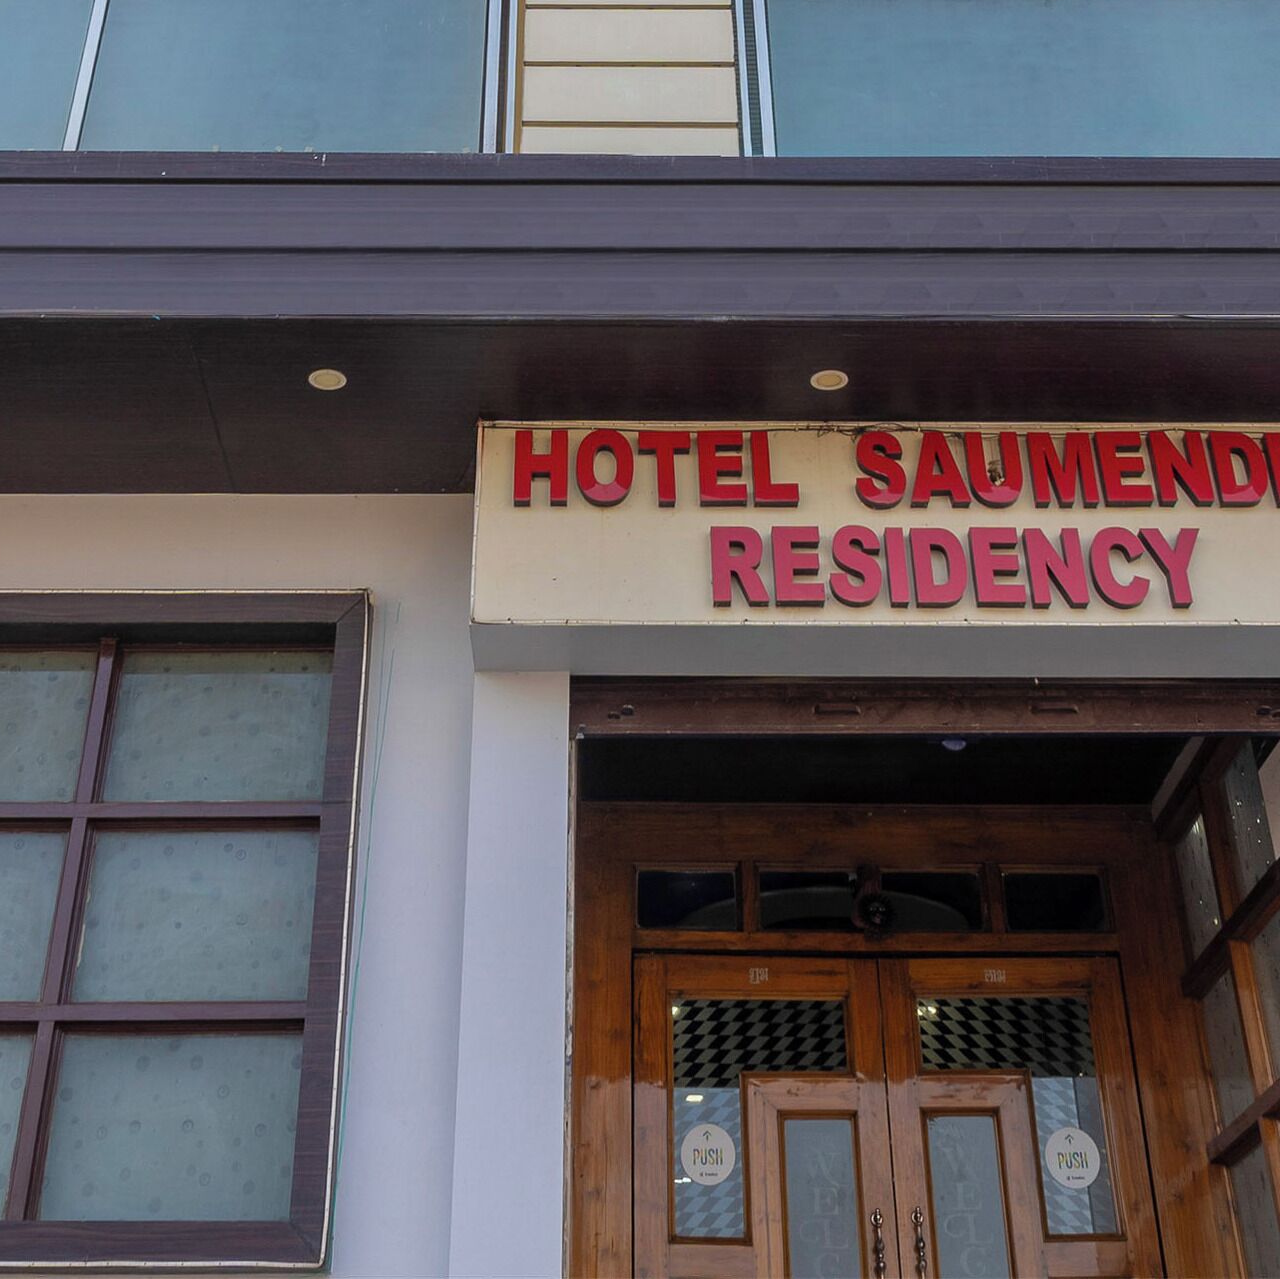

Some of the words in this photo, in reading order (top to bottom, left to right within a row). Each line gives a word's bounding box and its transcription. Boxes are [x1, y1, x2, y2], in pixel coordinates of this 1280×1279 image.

[513, 428, 800, 508] HOTEL
[710, 525, 1200, 610] RESIDENCY
[692, 1148, 724, 1166] PUSH
[1057, 1151, 1089, 1169] PUSH
